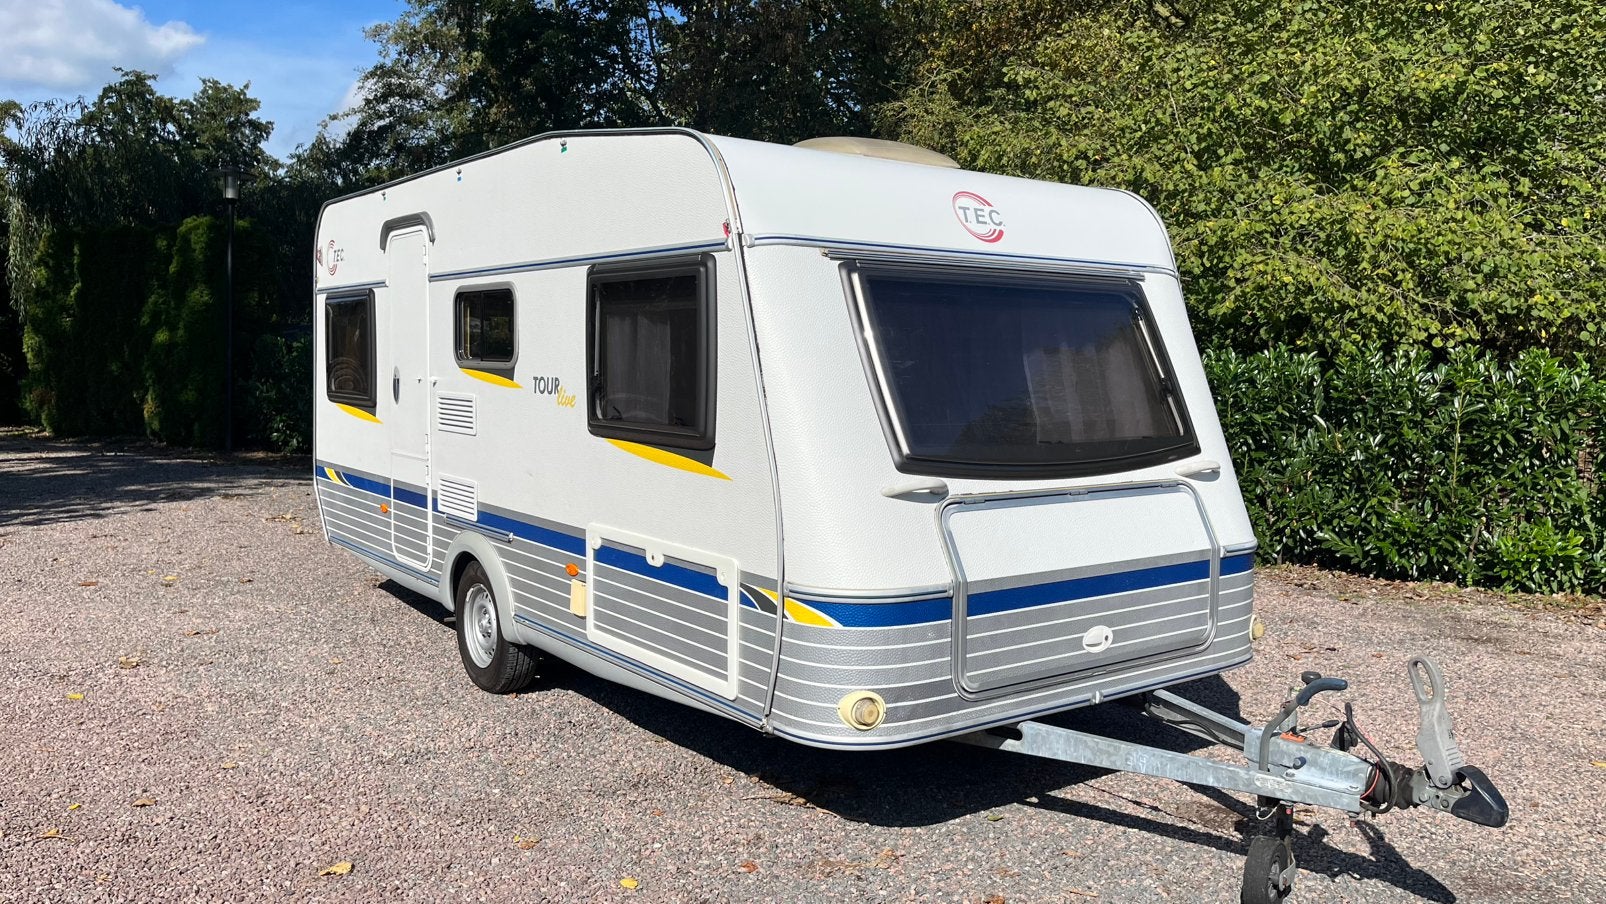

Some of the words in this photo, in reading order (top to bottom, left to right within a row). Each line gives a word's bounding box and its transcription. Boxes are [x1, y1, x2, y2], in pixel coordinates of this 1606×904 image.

[958, 206, 1006, 227] T.E.C.
[532, 376, 560, 395] TOUR
[556, 385, 576, 408] live
